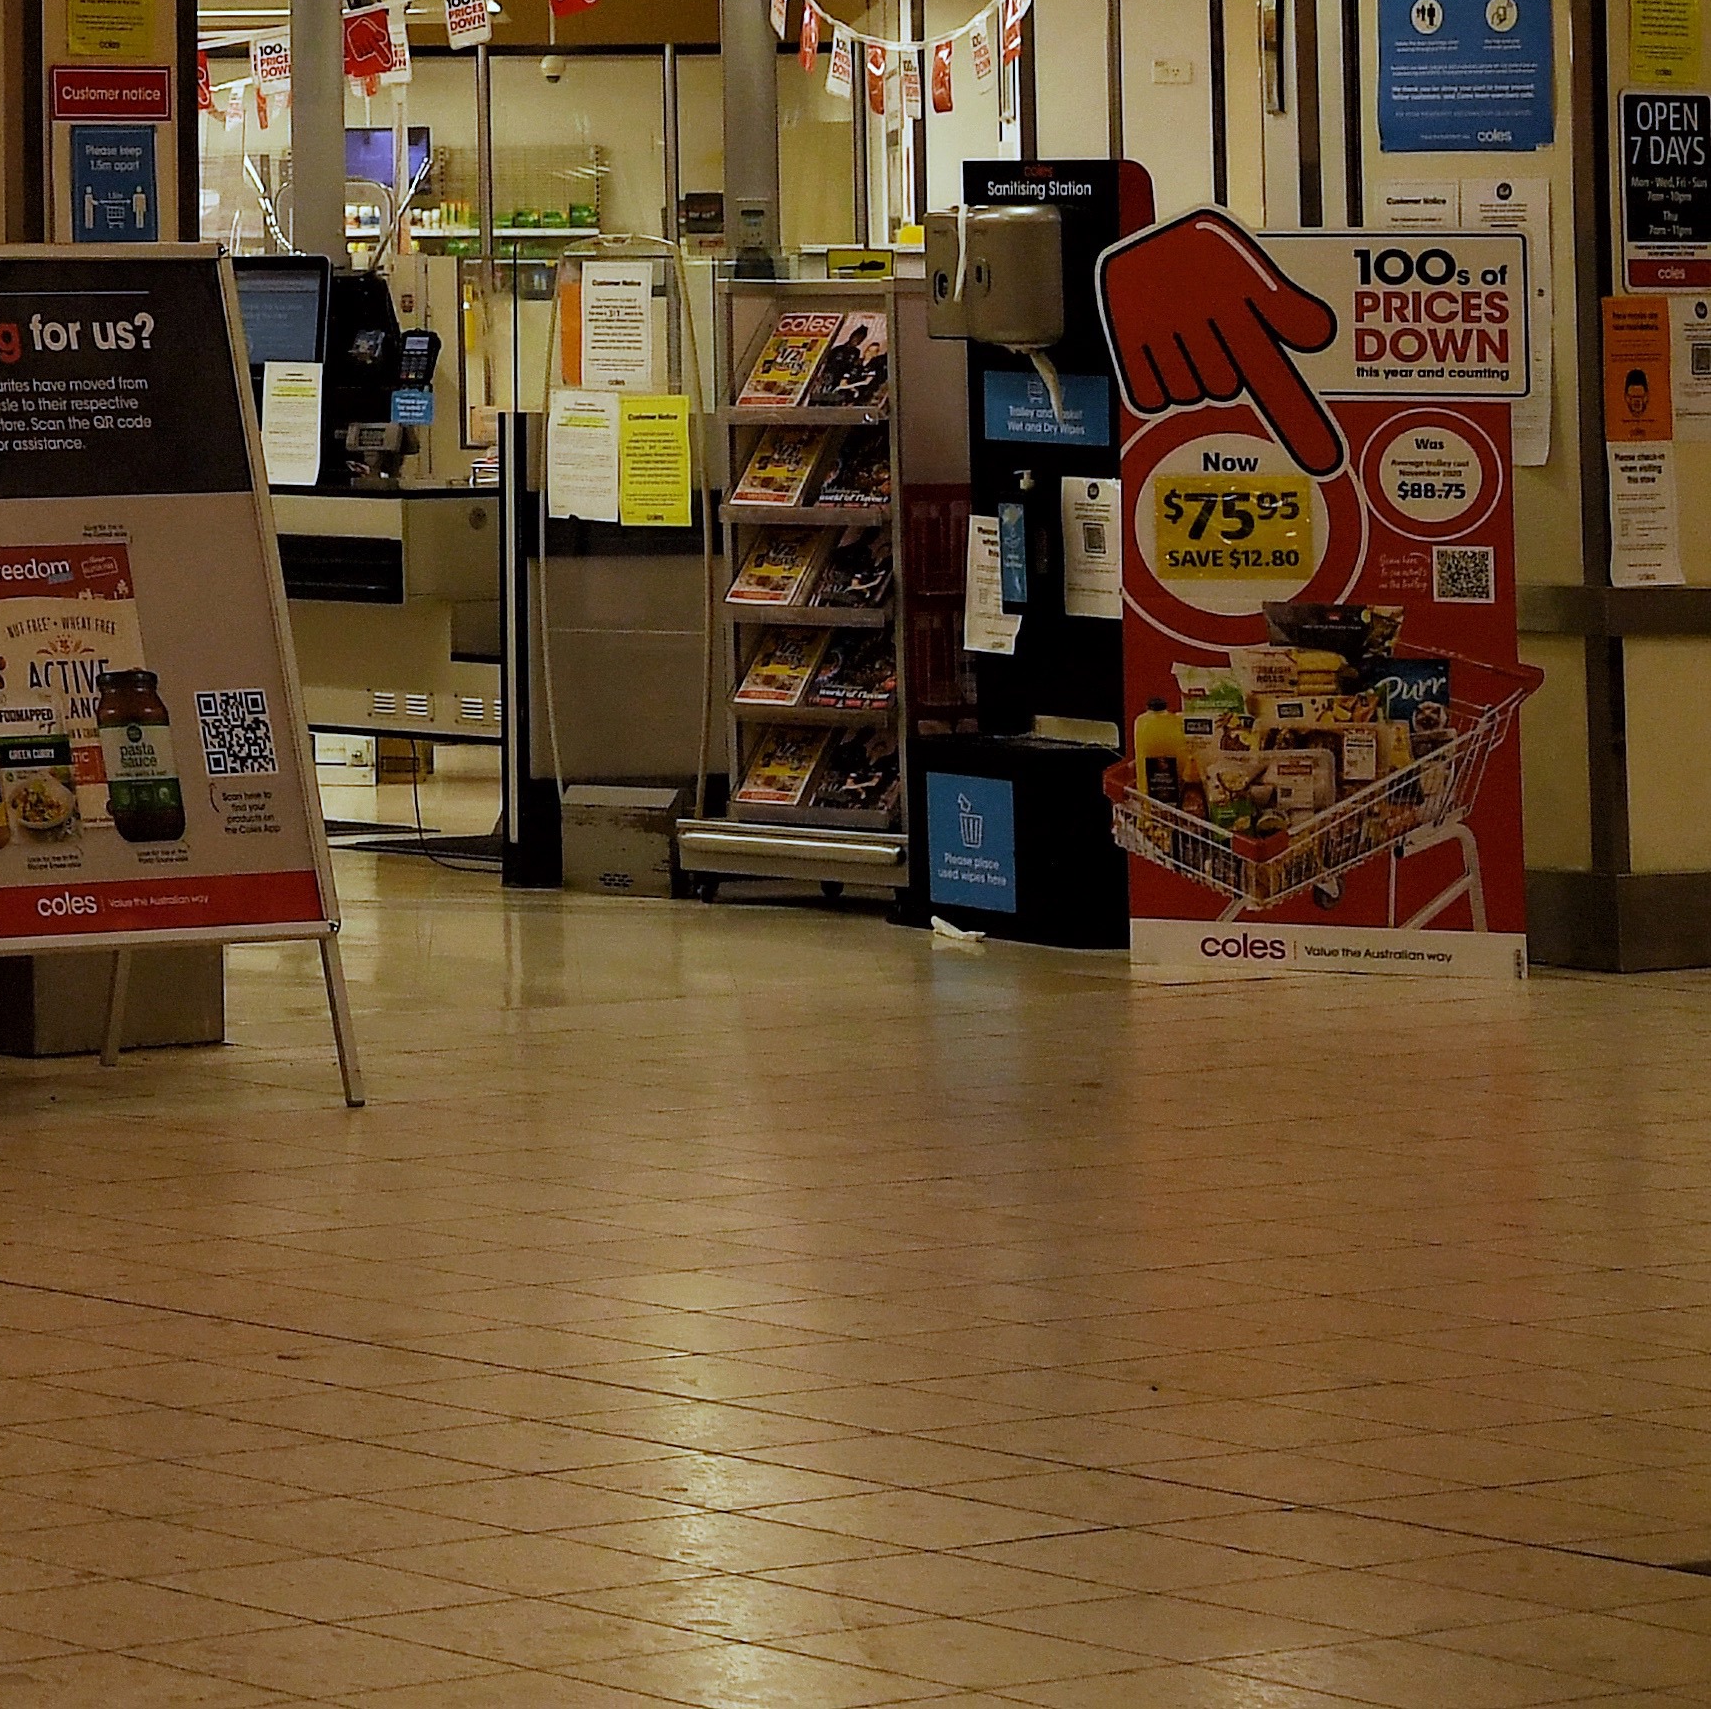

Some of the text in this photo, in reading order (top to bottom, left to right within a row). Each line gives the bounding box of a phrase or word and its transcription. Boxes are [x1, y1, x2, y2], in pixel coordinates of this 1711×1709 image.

[62, 87, 161, 101] Customer notice
[1636, 101, 1698, 131] OPEN
[1477, 128, 1512, 142] coles
[1630, 136, 1706, 166] 7 DAYS
[987, 181, 1092, 200] Sanitising Station
[1480, 265, 1508, 286] of
[1354, 291, 1510, 324] PRICES
[30, 313, 81, 352] for
[92, 311, 155, 352] us?
[779, 315, 836, 333] coles
[1354, 327, 1509, 363] DOWN
[33, 377, 67, 391] have
[69, 377, 116, 391] moved
[118, 376, 149, 391] from
[1356, 366, 1510, 382] this year and counting
[21, 397, 36, 411] to
[38, 396, 68, 411] their
[70, 396, 139, 414] respective
[30, 417, 65, 432] Scan
[68, 416, 90, 431] the
[93, 416, 115, 431] QR
[117, 415, 152, 430] code
[12, 437, 87, 451] assistance.
[1414, 438, 1445, 450] Was
[1202, 452, 1259, 473] Now
[1398, 480, 1466, 501] $88.75
[1168, 549, 1300, 569] SAVE $12.80
[1377, 673, 1447, 708] Purr
[119, 743, 155, 759] pasta
[121, 755, 158, 768] sauce
[37, 891, 97, 918] coles
[1200, 932, 1453, 964] coles Value the Australian way
